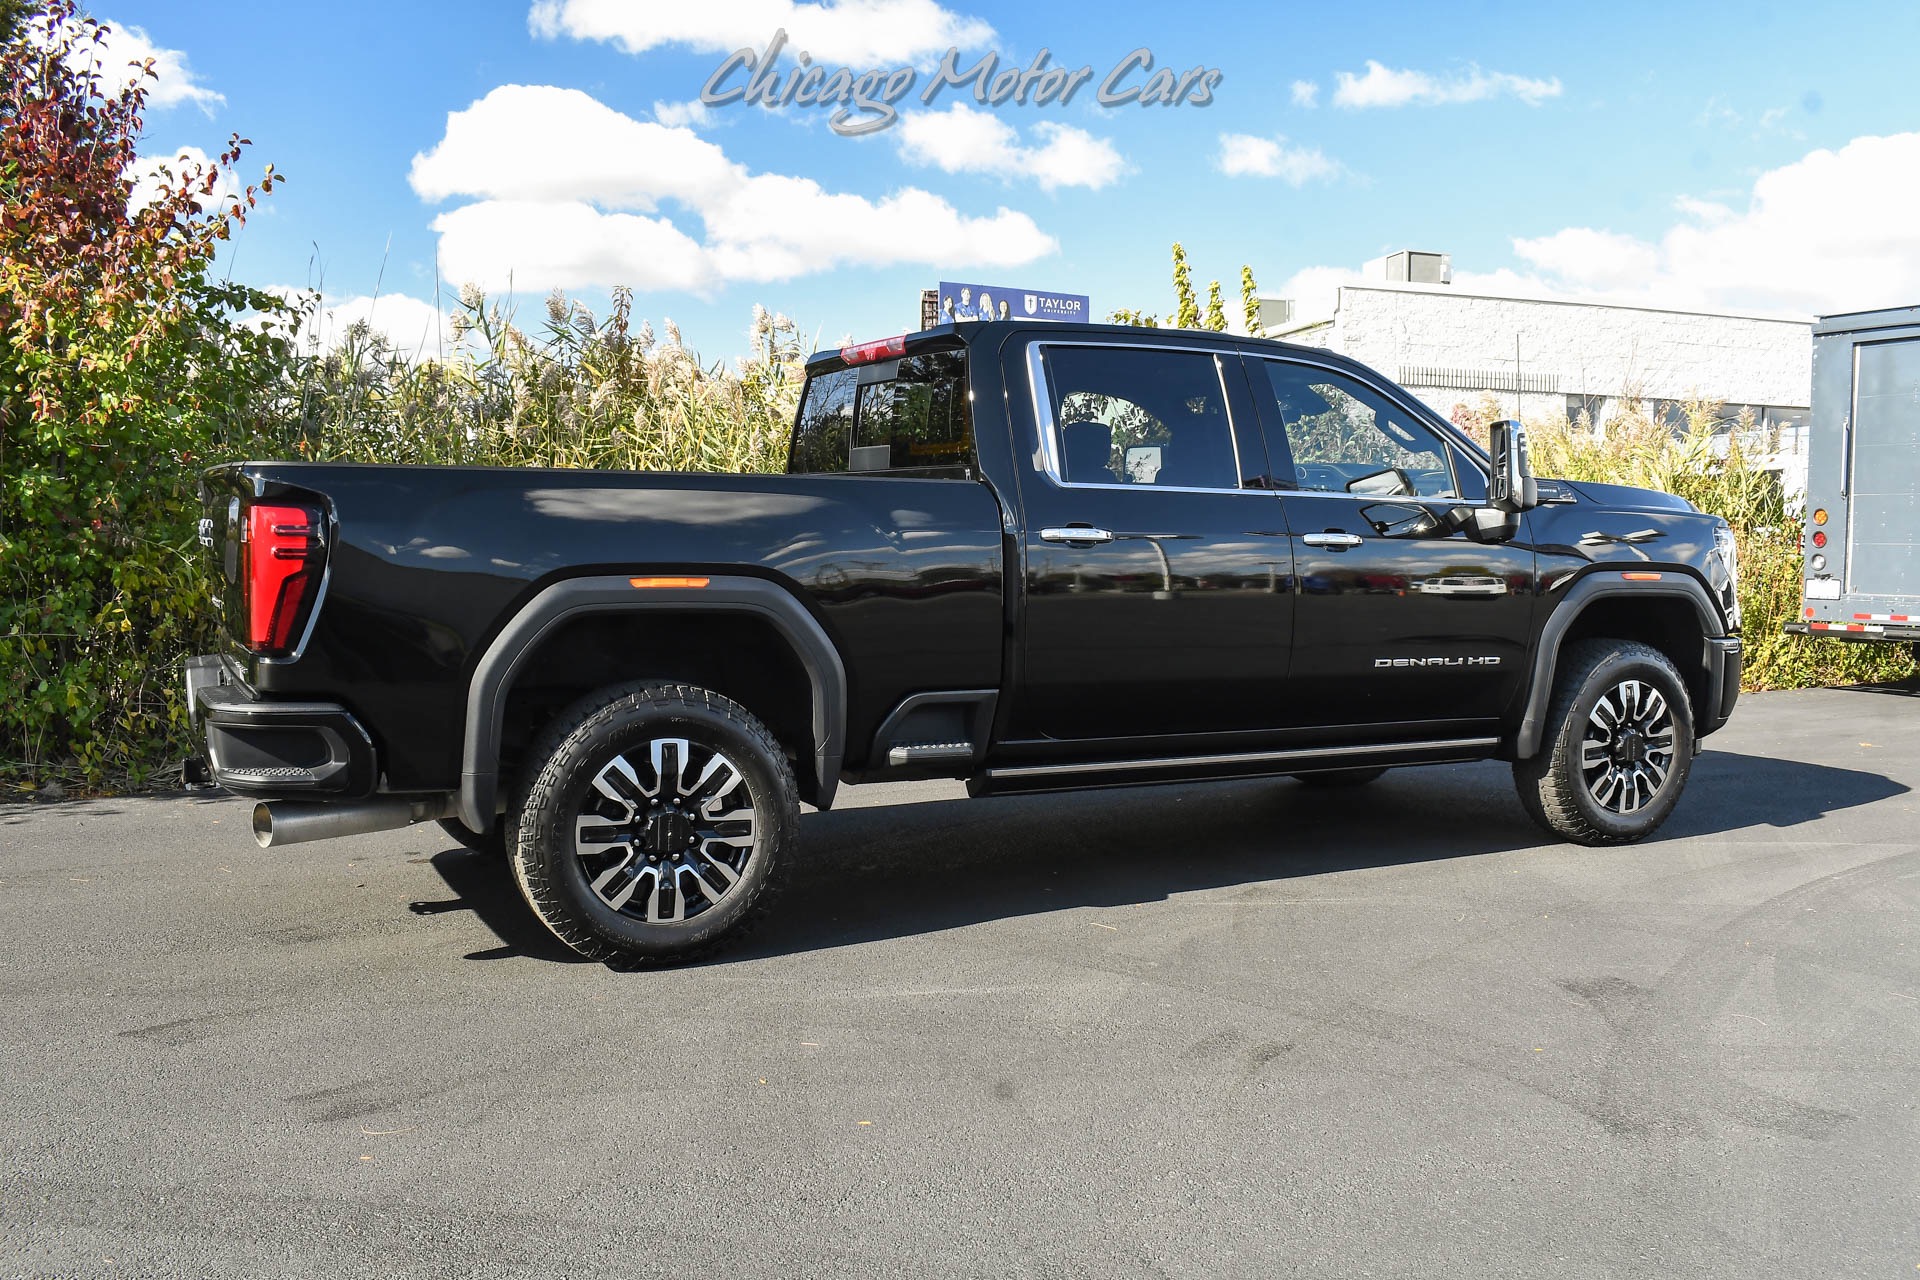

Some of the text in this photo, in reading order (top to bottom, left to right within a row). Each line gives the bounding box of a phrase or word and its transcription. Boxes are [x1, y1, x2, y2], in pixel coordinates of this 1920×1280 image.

[1039, 298, 1080, 310] TAYLOR
[1374, 656, 1501, 667] DENALI HD
